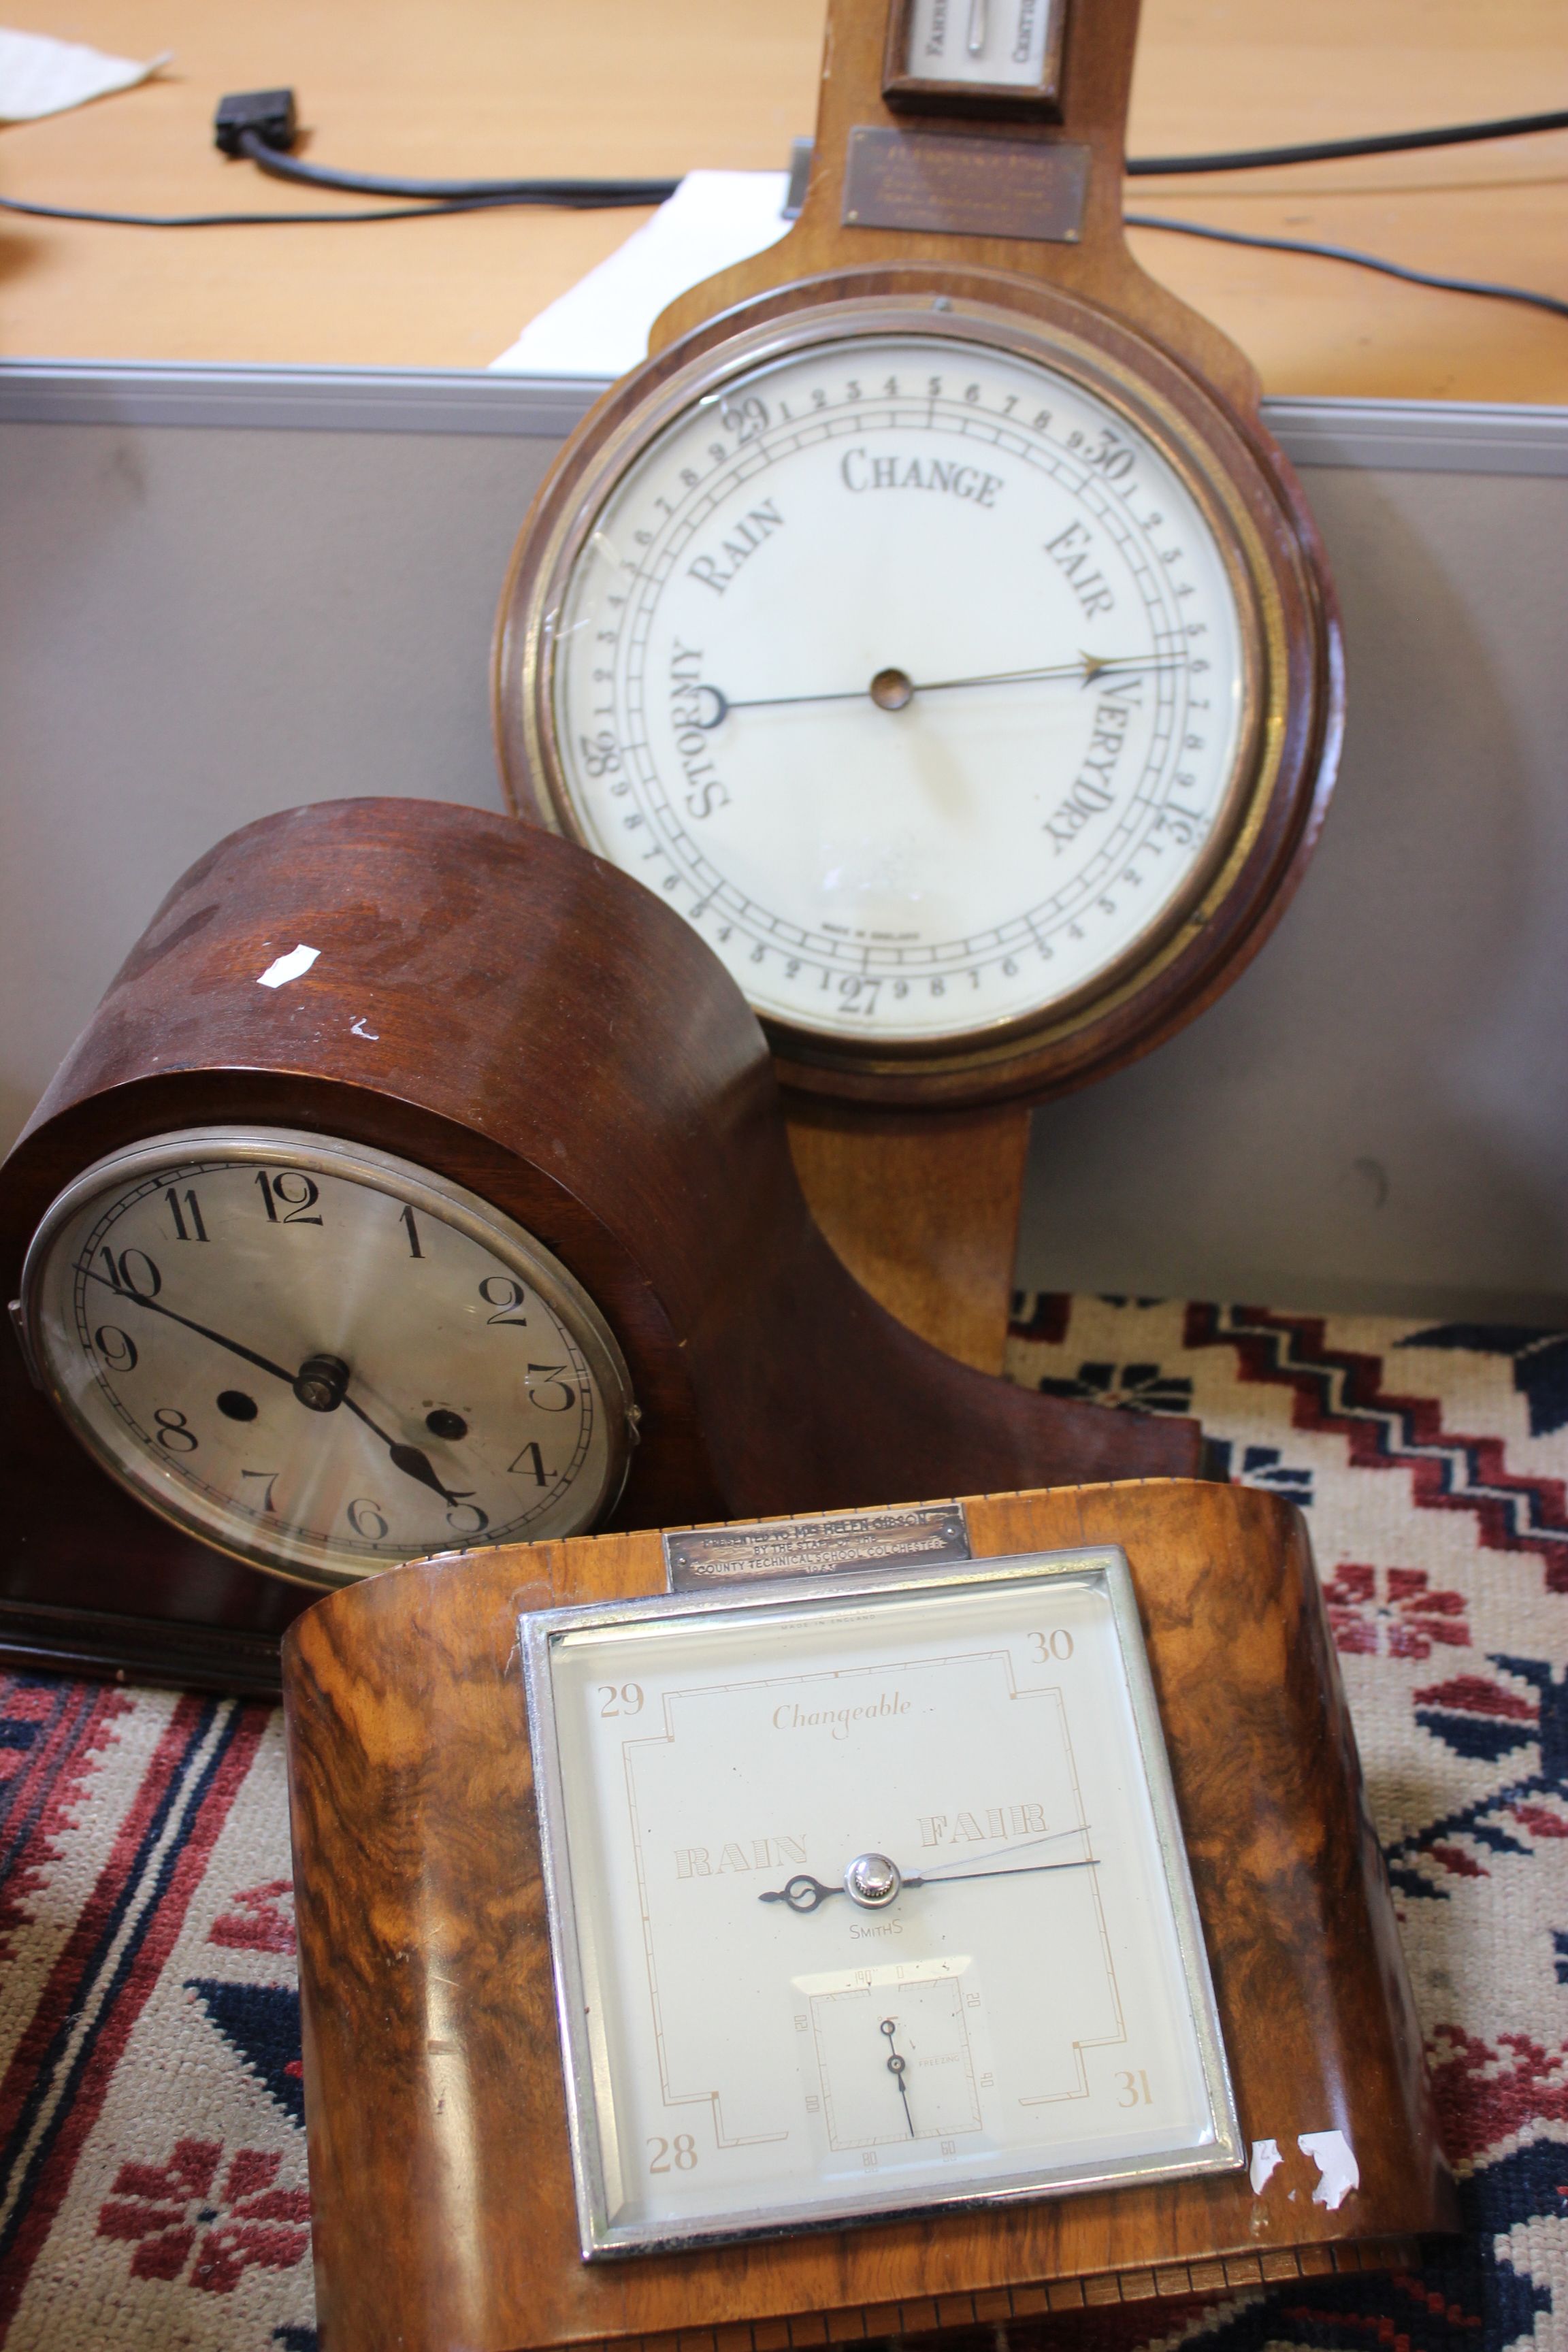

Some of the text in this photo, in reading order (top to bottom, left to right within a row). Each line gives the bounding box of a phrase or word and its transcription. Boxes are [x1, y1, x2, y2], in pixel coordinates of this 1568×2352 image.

[722, 397, 769, 444] 29
[1084, 427, 1136, 480] 30
[841, 447, 1004, 508] CHANGE
[687, 497, 786, 598] RAIN
[1043, 519, 1115, 622] FAIR
[671, 638, 730, 819] STORMY
[580, 731, 623, 778] 28
[838, 977, 882, 1015] 27
[165, 1188, 210, 1242] 11
[254, 1171, 323, 1226] 12
[399, 1205, 425, 1258] 1
[99, 1245, 161, 1298] 10
[478, 1276, 527, 1326] 2
[95, 1325, 138, 1372] 9
[527, 1363, 576, 1412] 3
[154, 1408, 199, 1452] 8
[507, 1442, 557, 1487] 4
[242, 1469, 279, 1512] 7
[446, 1491, 489, 1533] 5
[347, 1499, 388, 1540] 6
[697, 1539, 943, 1574] COUNTY TECHNICAL SCHOOL COLCHESTER
[754, 1546, 767, 1555] BY
[773, 1542, 793, 1552] THE
[1027, 1629, 1075, 1664] 30
[598, 1683, 644, 1718] 29
[772, 1690, 912, 1740] Changeable
[917, 1803, 1049, 1848] FAIR
[674, 1834, 807, 1880] RAIN
[919, 2055, 960, 2067] FREEZING
[1114, 2069, 1154, 2108] 31
[647, 2134, 698, 2174] 28
